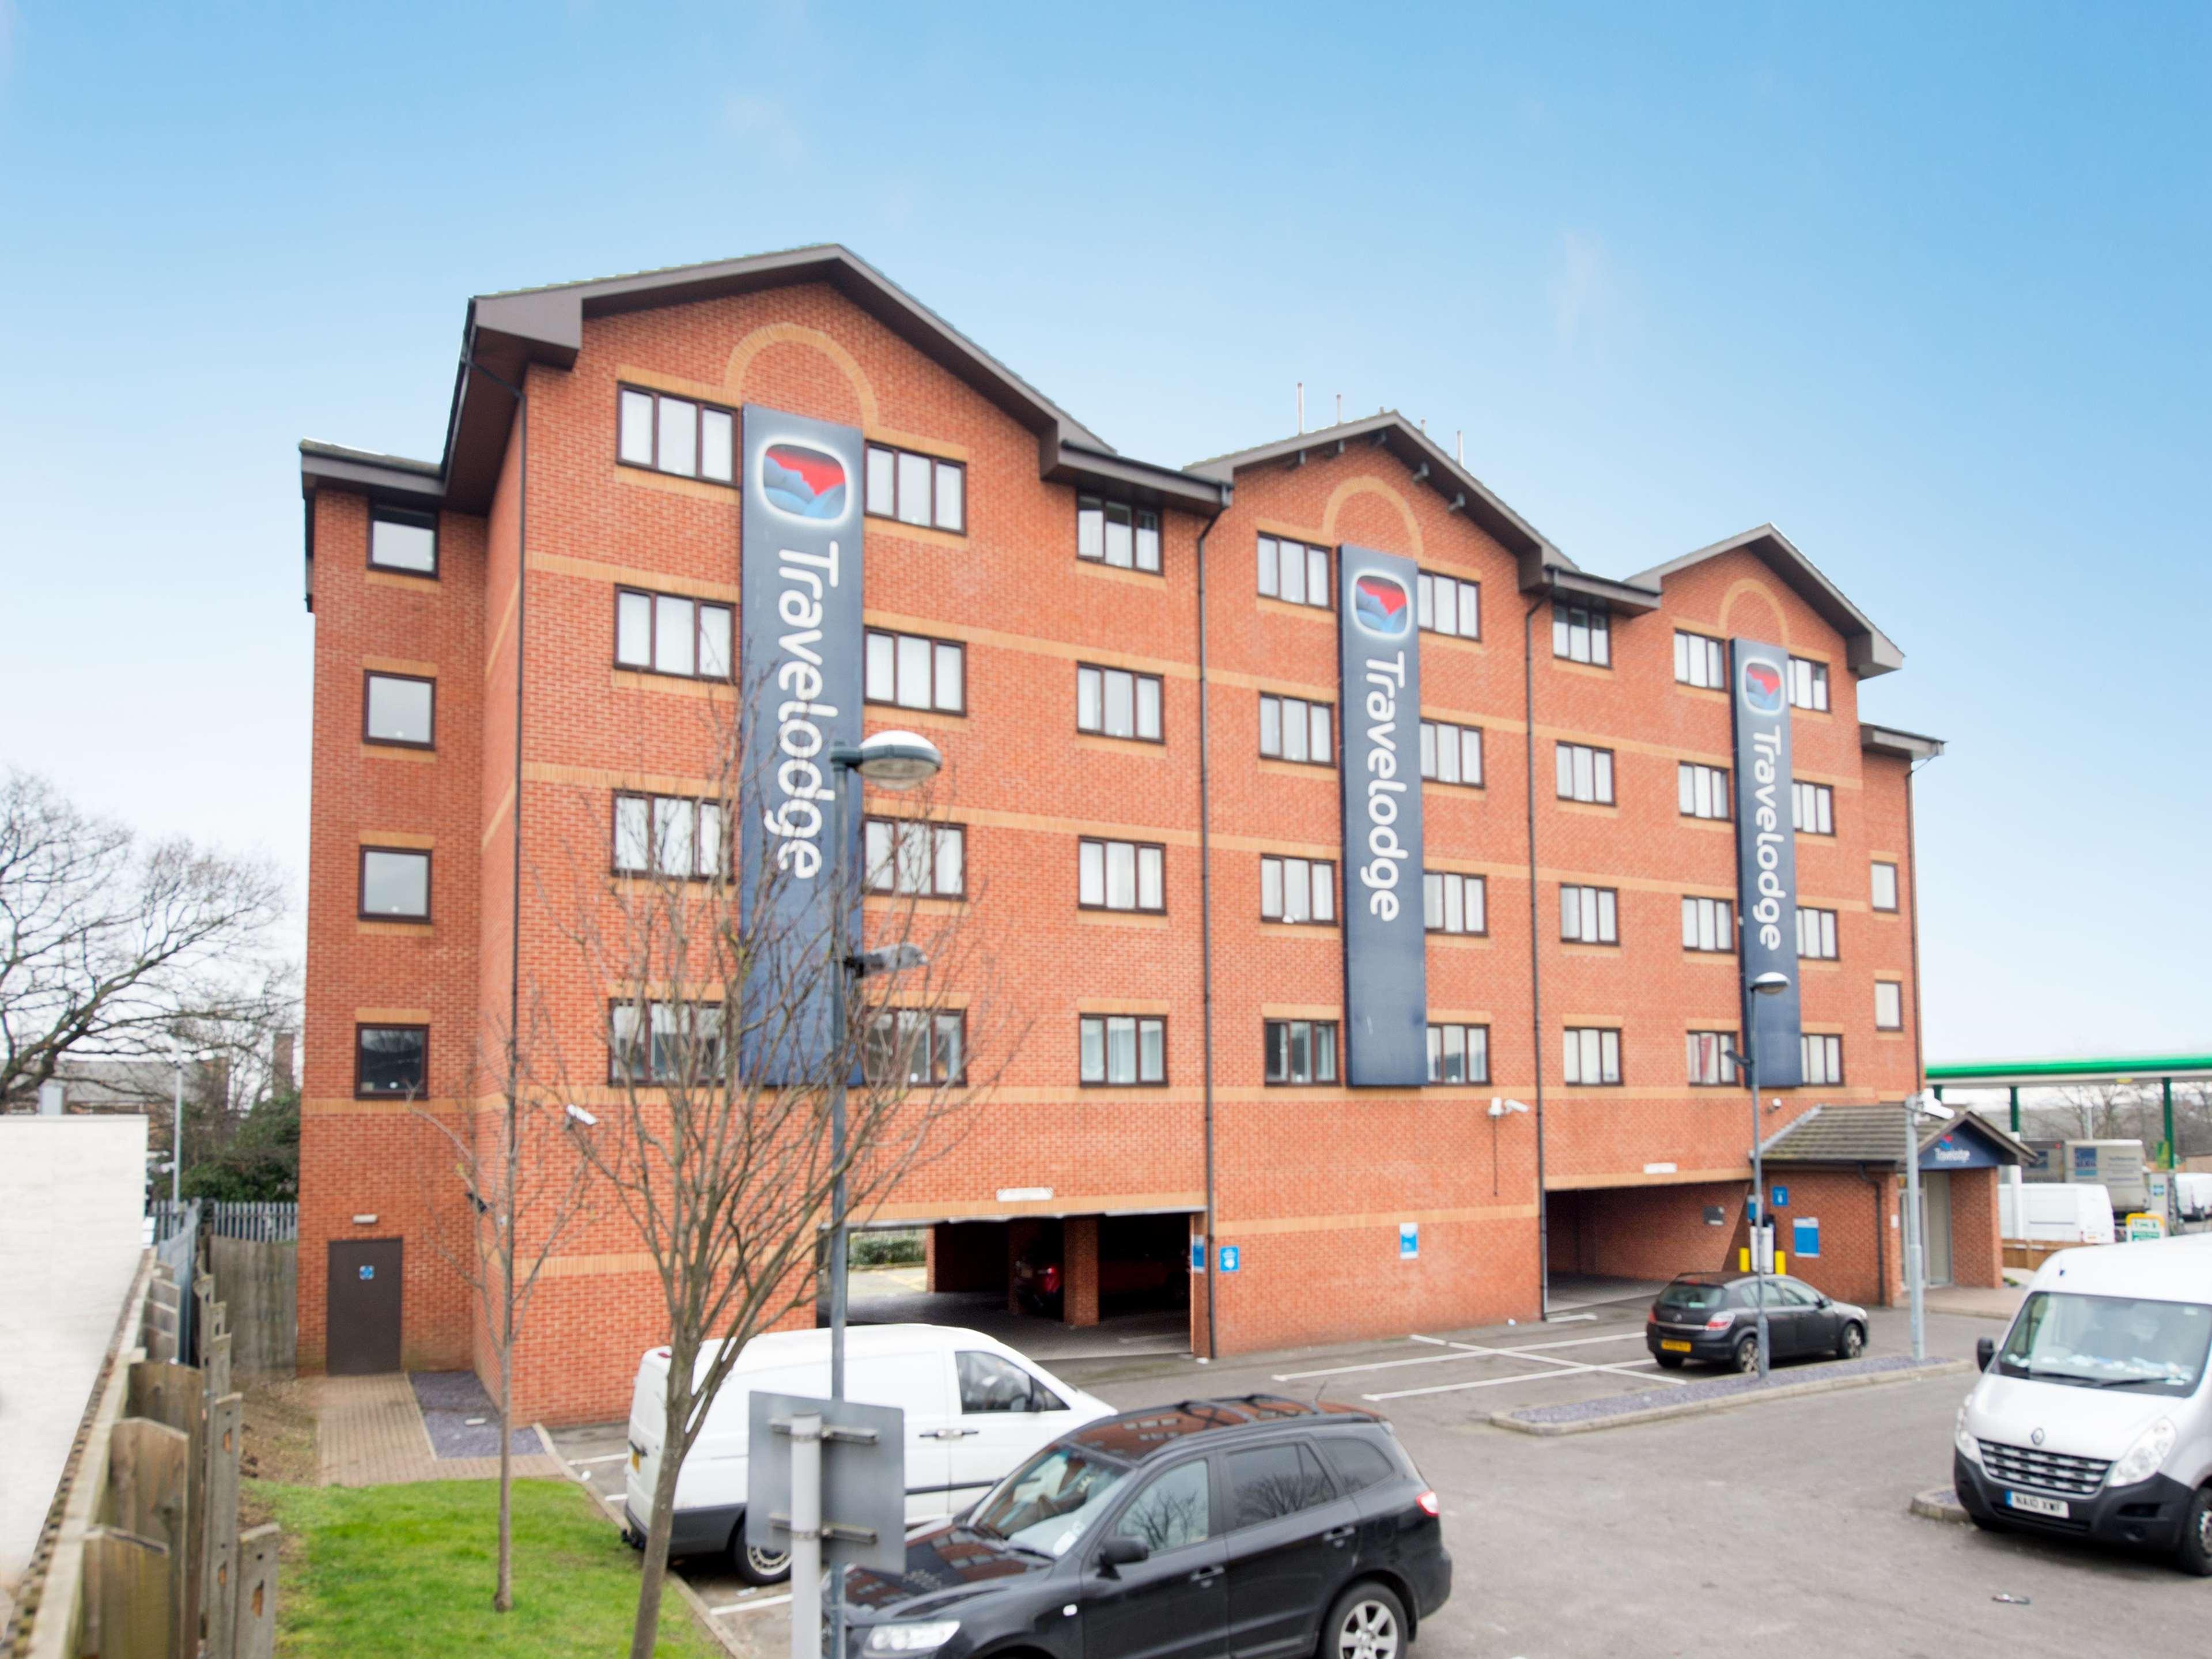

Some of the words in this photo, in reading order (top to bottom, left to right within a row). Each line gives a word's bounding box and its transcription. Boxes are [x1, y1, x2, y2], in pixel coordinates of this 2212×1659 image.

[764, 540, 839, 879] Travelodge
[1360, 651, 1408, 922] Travelodge
[1752, 724, 1787, 951] Travelodge
